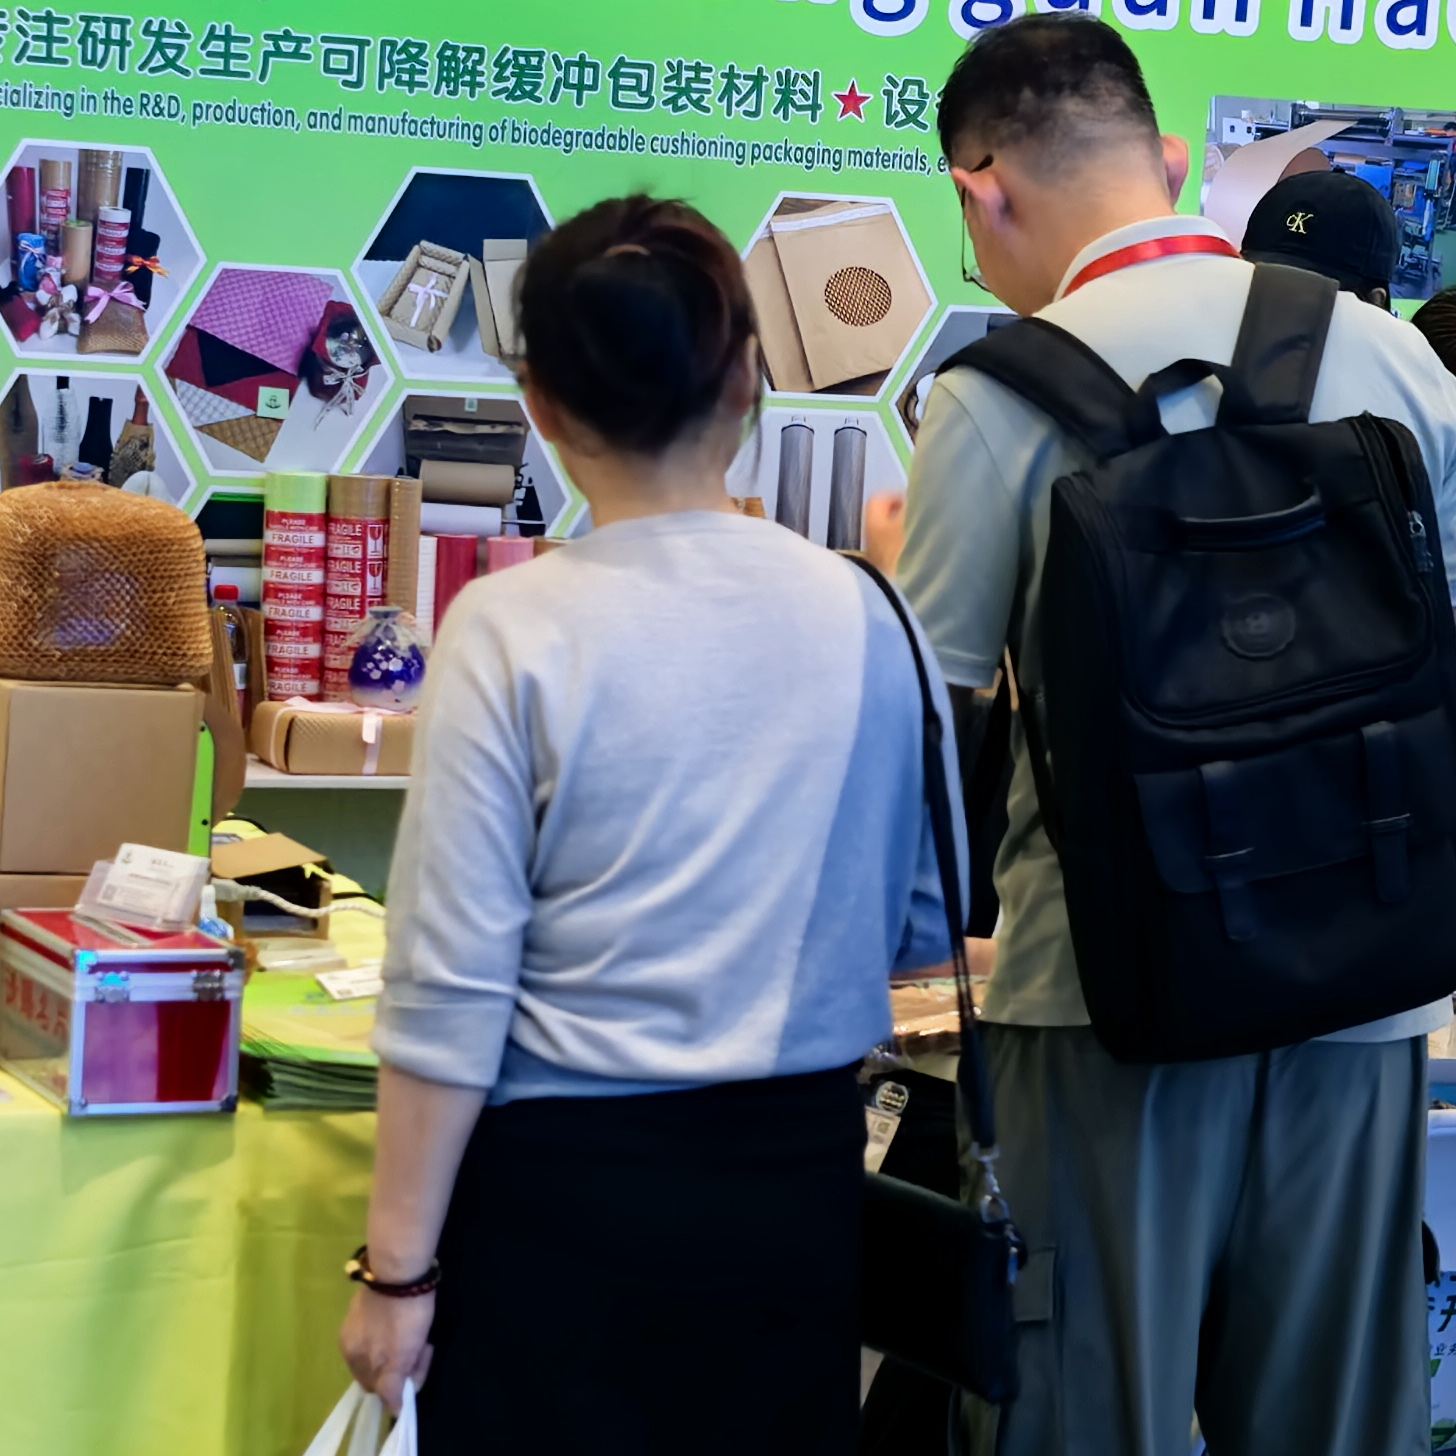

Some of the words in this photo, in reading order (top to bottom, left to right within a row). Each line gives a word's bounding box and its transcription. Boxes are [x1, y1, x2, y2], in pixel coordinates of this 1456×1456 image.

[81, 86, 97, 113] in
[103, 89, 134, 116] the
[139, 92, 187, 124] R&D,
[192, 97, 301, 132] production,
[307, 105, 342, 133] and
[347, 110, 484, 148] manufacturing
[489, 120, 509, 144] of
[510, 119, 645, 156] biodegradable
[650, 133, 745, 165] cushioning
[750, 139, 843, 172] packaging
[846, 145, 933, 178] materials,
[329, 523, 362, 536] FRAGILE
[272, 534, 314, 544] FRAGILE
[328, 560, 362, 573] FRAGILE
[270, 571, 313, 581] FRAGILE
[326, 597, 361, 610] FRAGILE
[268, 607, 311, 618] FRAGILE
